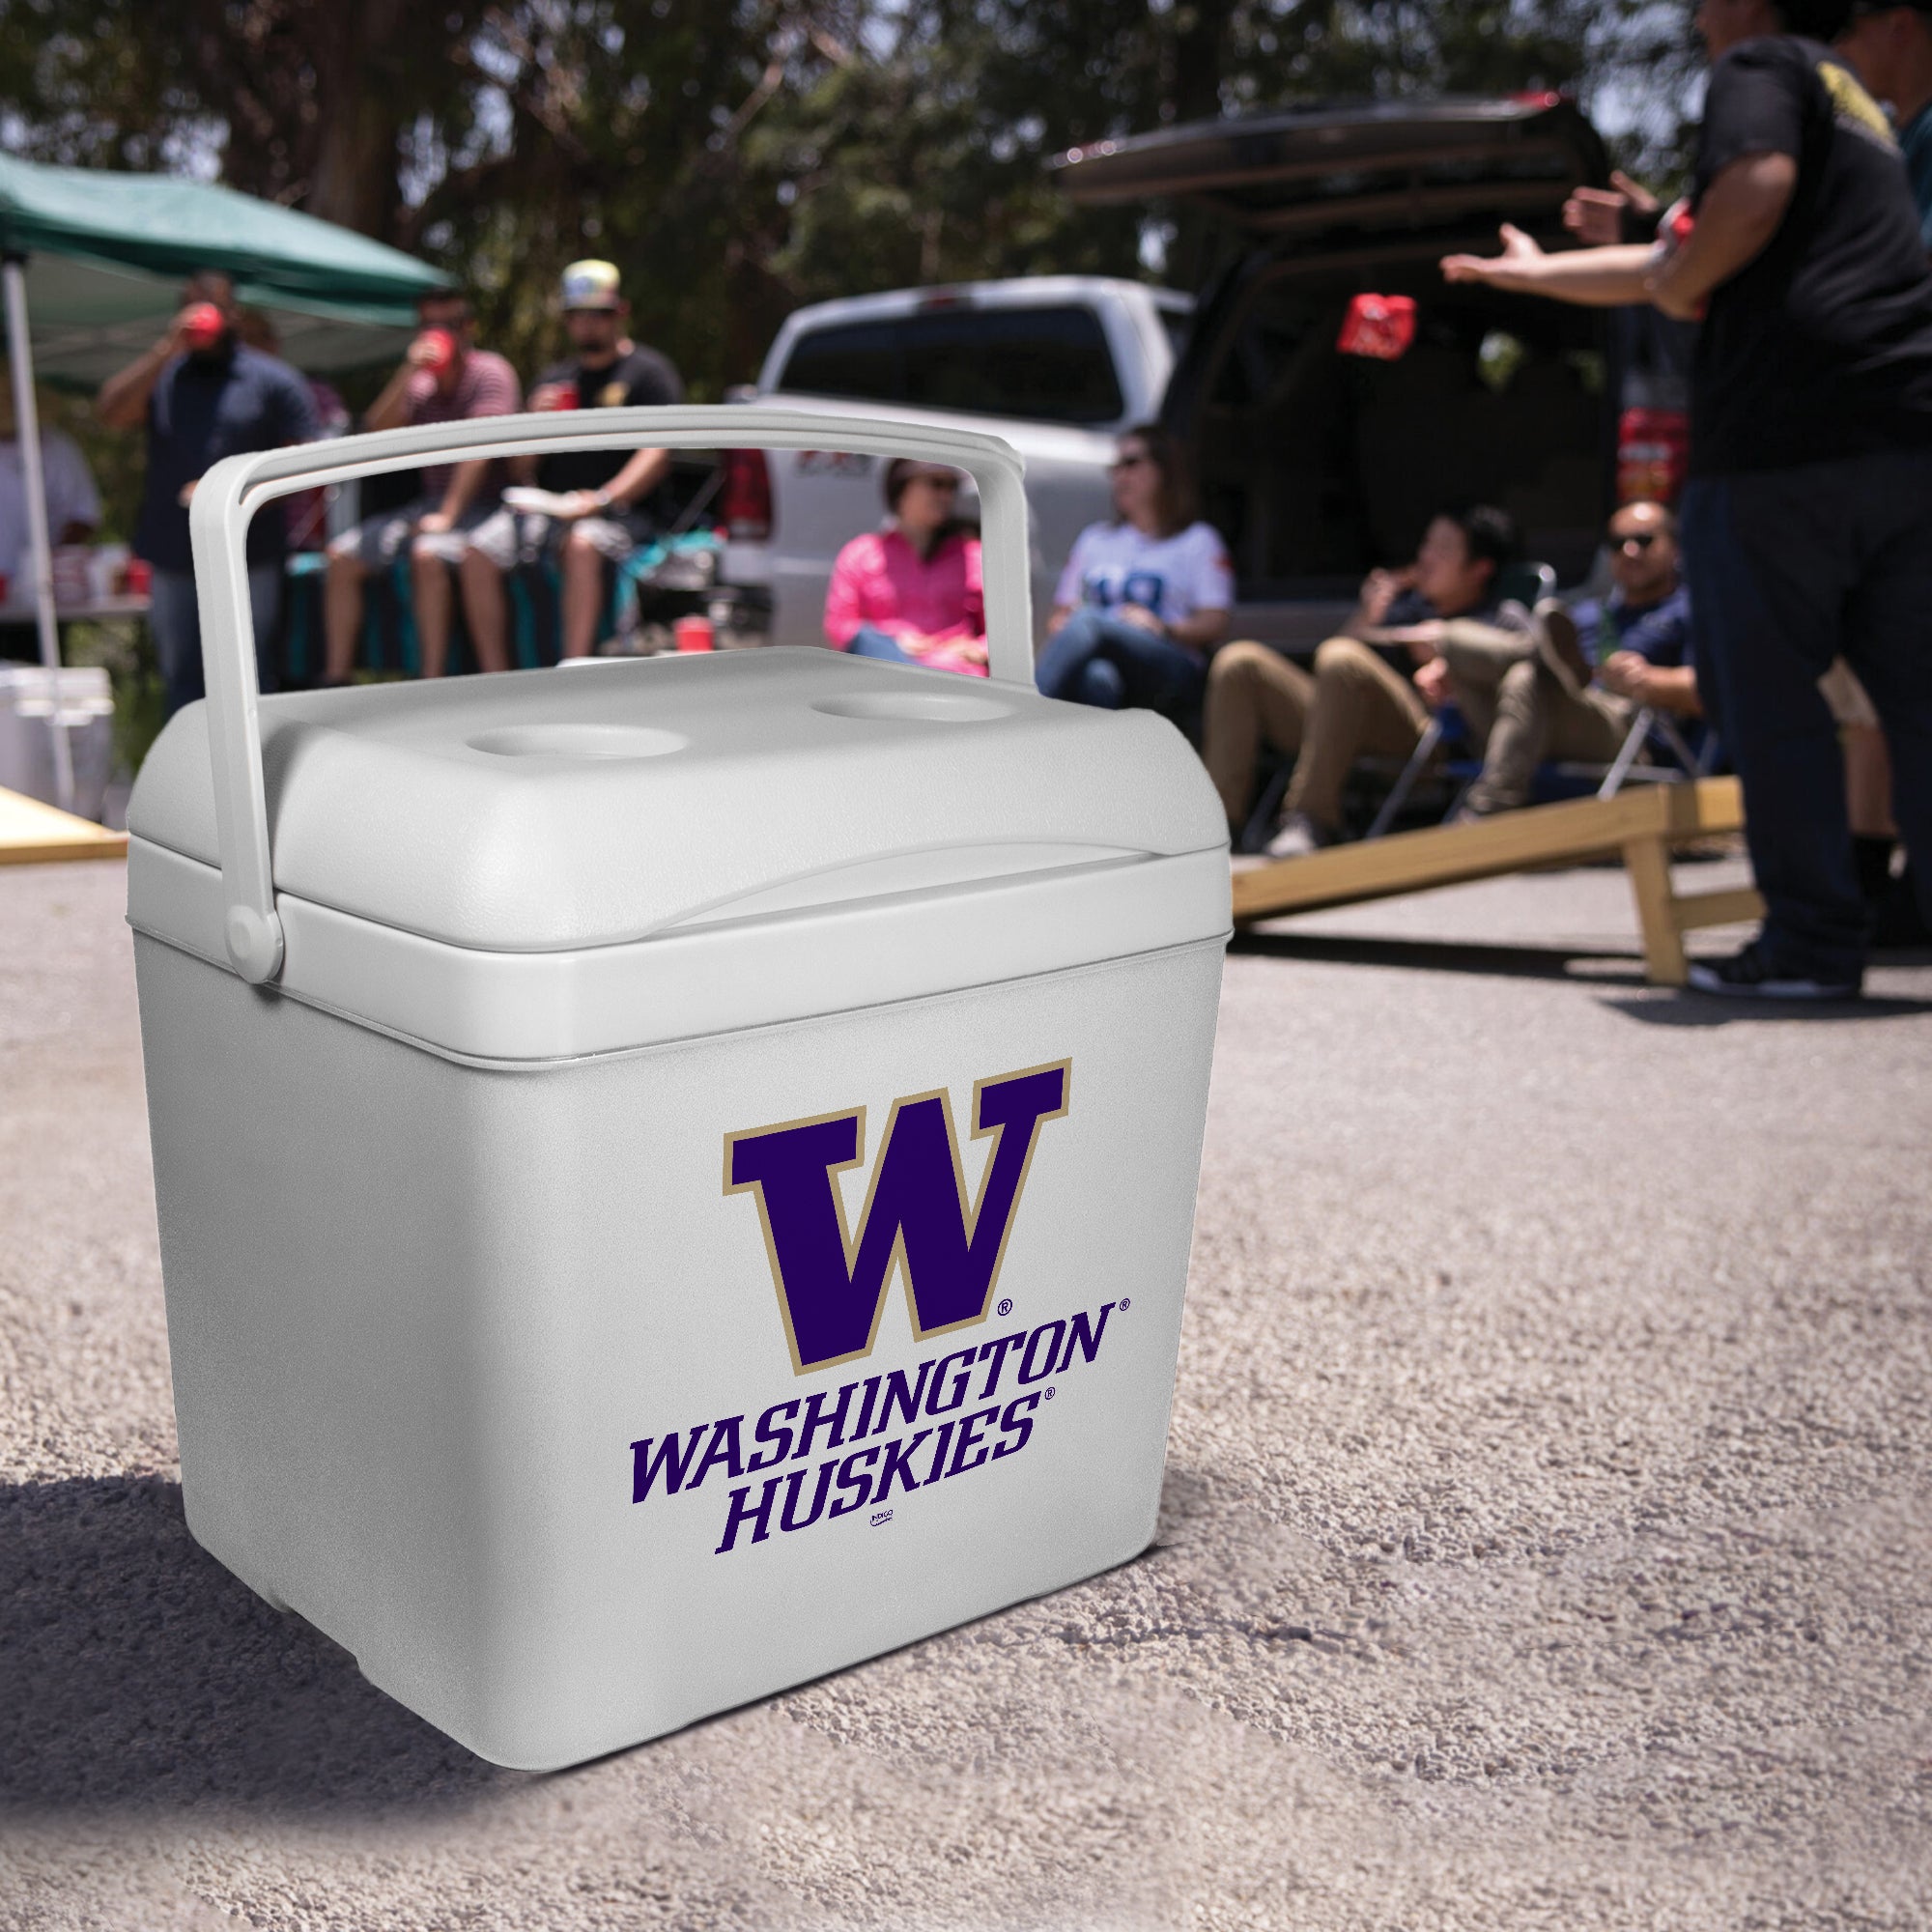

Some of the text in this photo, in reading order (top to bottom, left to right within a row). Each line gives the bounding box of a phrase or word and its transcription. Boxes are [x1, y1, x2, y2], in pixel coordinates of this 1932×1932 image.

[722, 1056, 1073, 1378] W
[629, 1301, 1117, 1505] WASHINGTON
[714, 1390, 1042, 1555] HUSKIES
